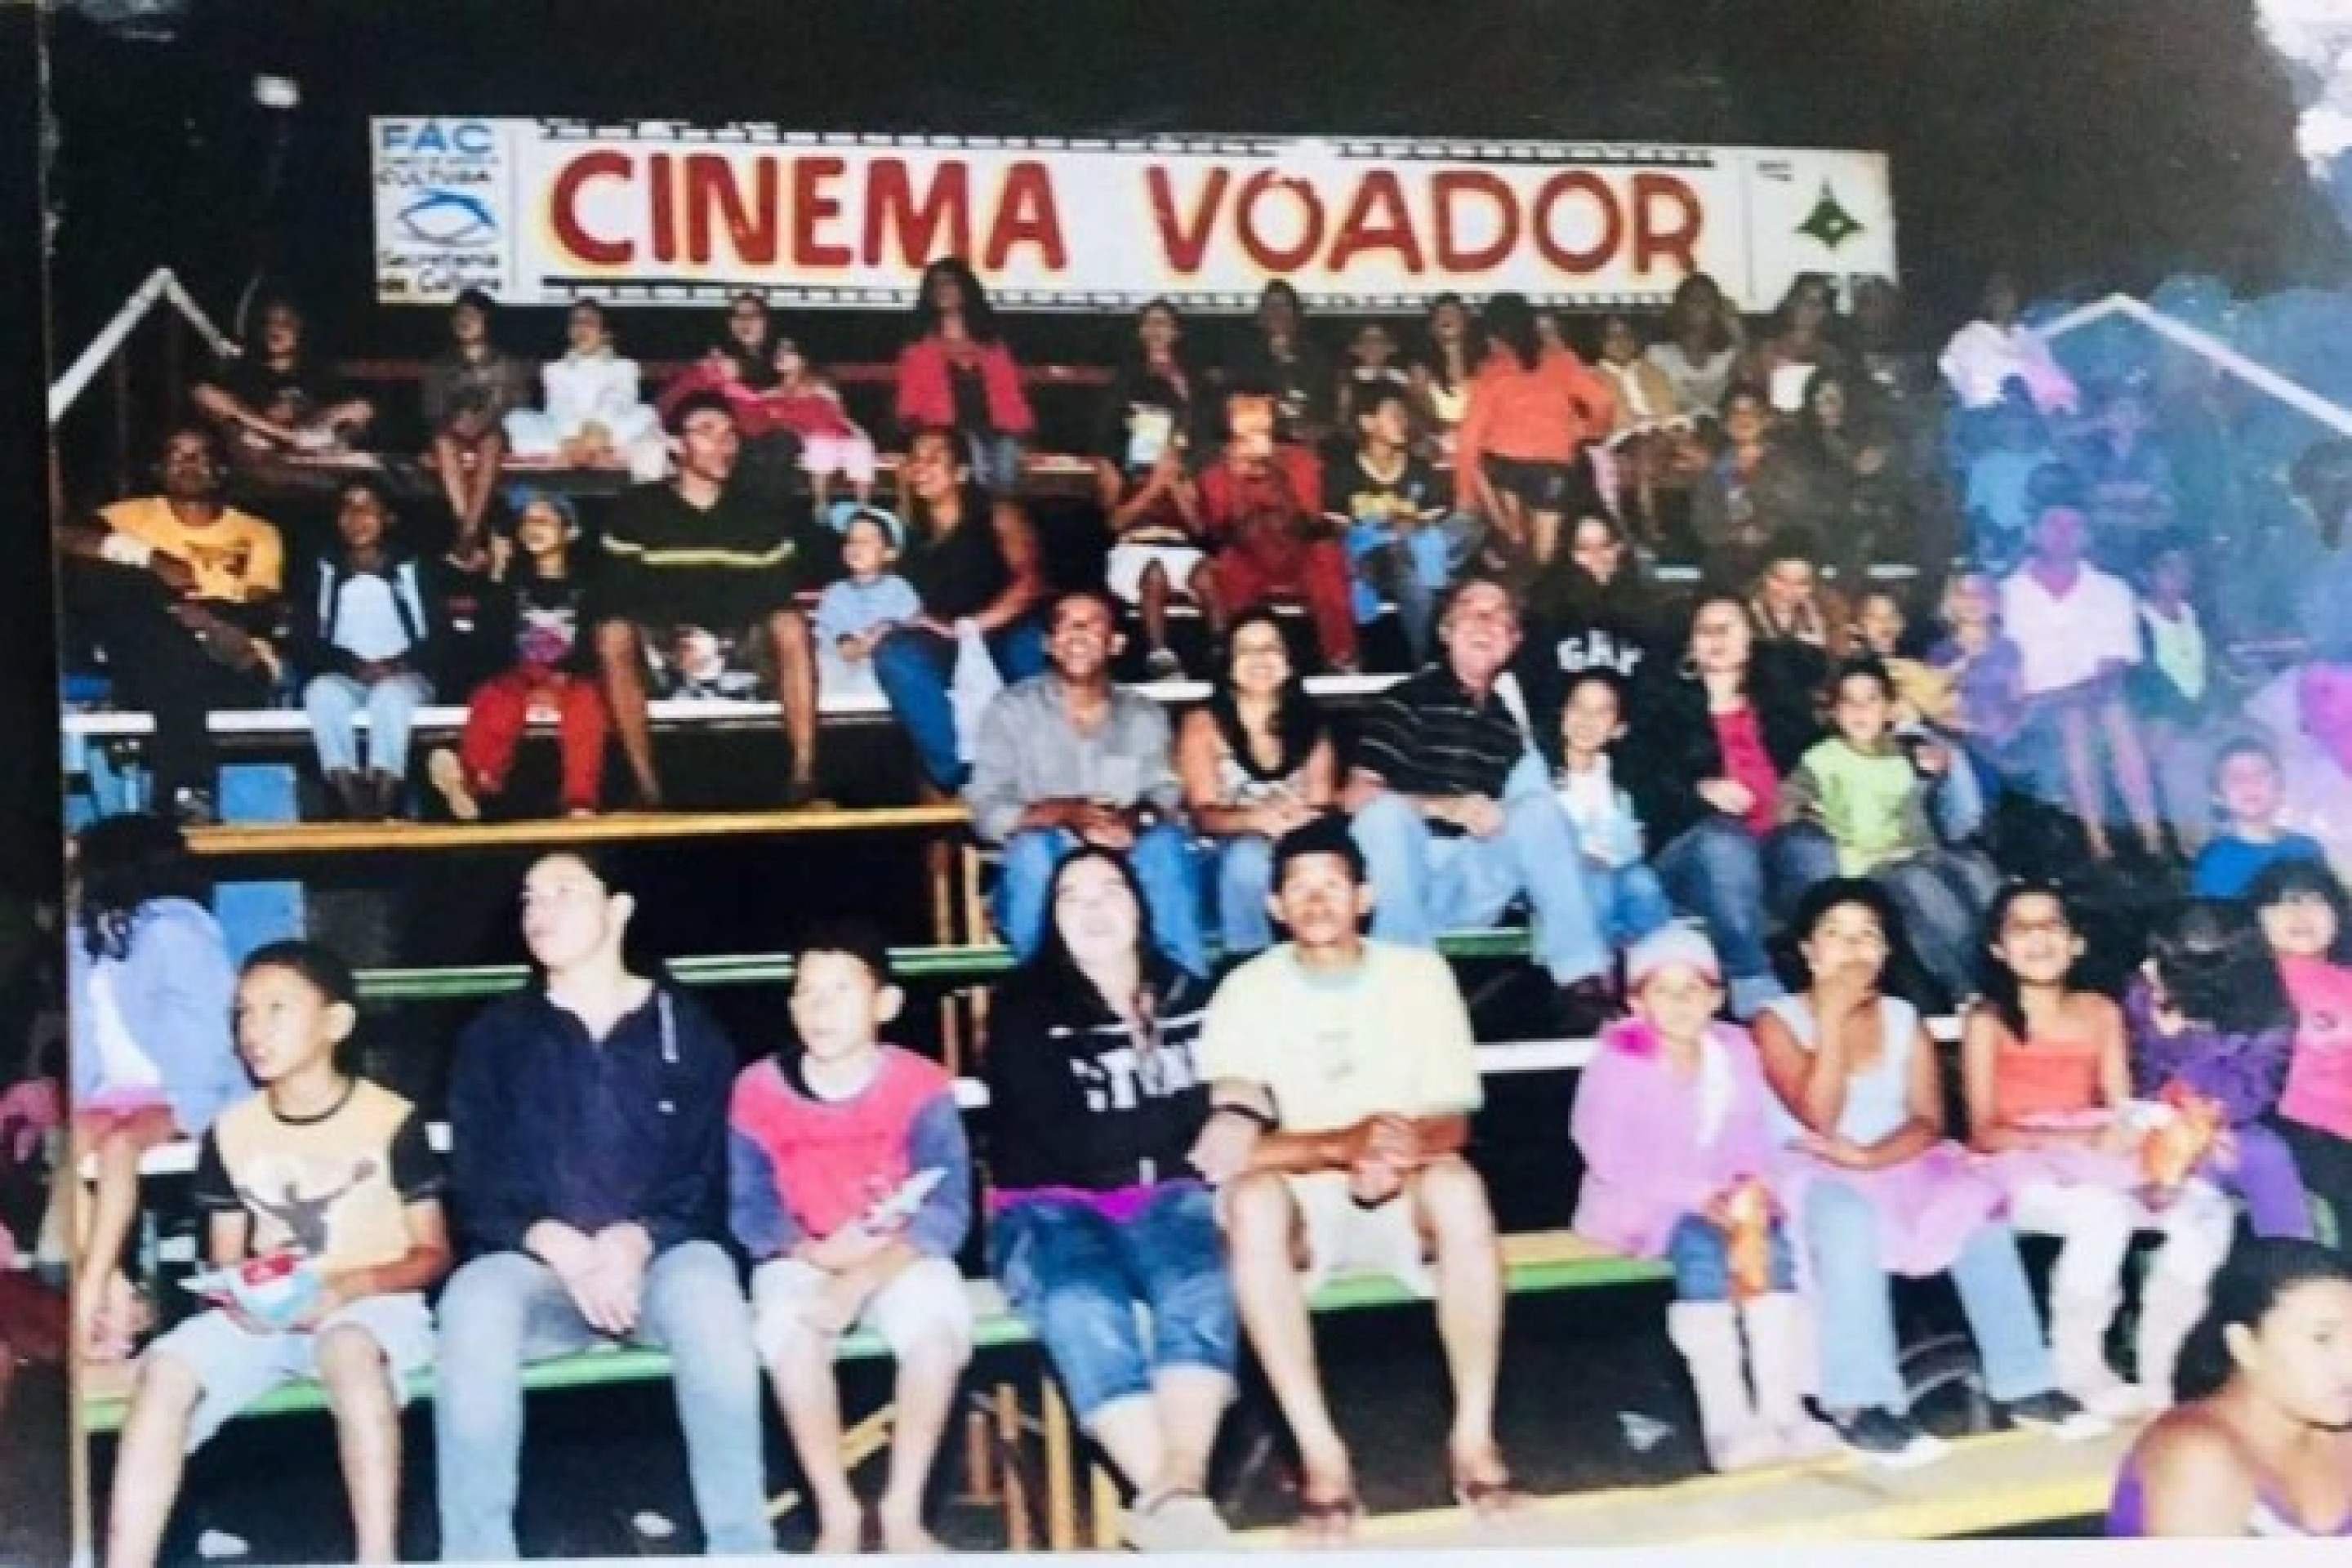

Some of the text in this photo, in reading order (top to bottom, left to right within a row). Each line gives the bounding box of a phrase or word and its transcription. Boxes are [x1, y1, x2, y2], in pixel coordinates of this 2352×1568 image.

[381, 119, 493, 154] FAC
[549, 149, 1704, 274] CINEMA VOADOR
